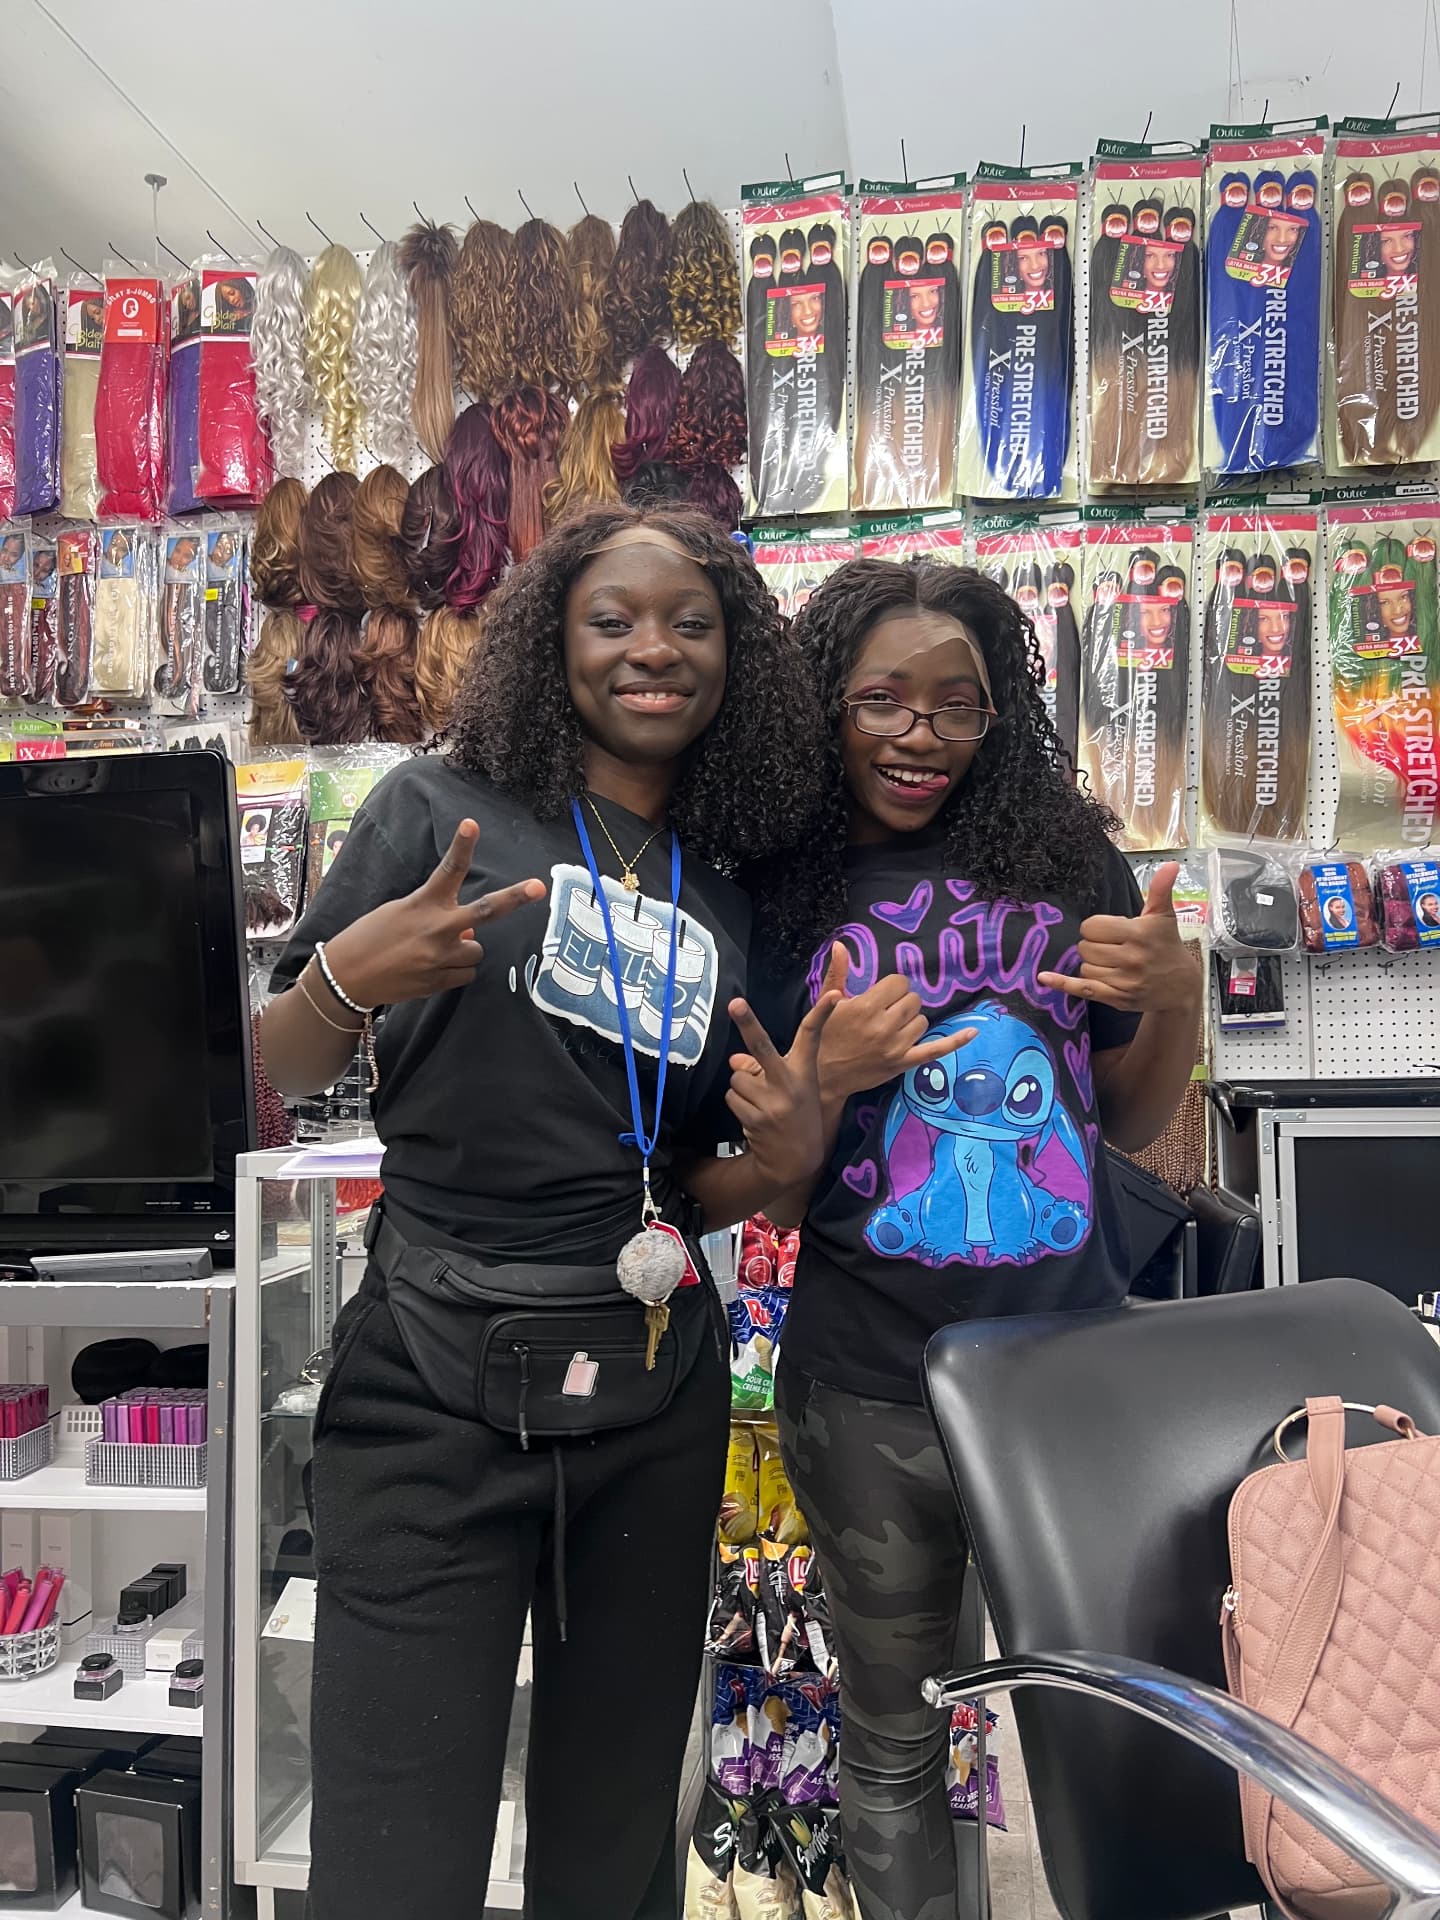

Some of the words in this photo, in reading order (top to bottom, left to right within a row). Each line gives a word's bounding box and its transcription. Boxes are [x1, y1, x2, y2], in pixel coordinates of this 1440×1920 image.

[1216, 127, 1245, 137] Outre
[1346, 120, 1371, 132] Outre
[1101, 143, 1127, 155] Outre
[865, 184, 892, 193] Outre
[979, 165, 1006, 177] Outre
[752, 186, 780, 196] Outre
[1232, 213, 1253, 252] Premium
[992, 252, 1000, 289] Premium
[1114, 244, 1129, 281] Premium
[1351, 234, 1362, 274] Premium
[1252, 263, 1290, 286] 3X
[1380, 274, 1417, 300] 3X
[884, 290, 893, 328] Premium
[1022, 290, 1051, 314] 3X
[1137, 290, 1171, 312] 3X
[793, 335, 821, 358] 3X
[911, 327, 942, 347] 3X
[1367, 310, 1392, 392] X-Pression
[1395, 282, 1419, 420] PRE-STRETCHED
[1122, 331, 1144, 414] X-Pression
[1146, 308, 1169, 440] PRE-STRETCHED
[1238, 316, 1262, 400] X-Pression
[1263, 288, 1286, 426] PRE-STRETCHED
[797, 343, 817, 471] RE-STRETCED
[904, 338, 926, 467] PRE-STRETCHED
[989, 349, 1012, 429] X-Pression
[1010, 324, 1037, 457] PRE-STRETCHED
[1090, 508, 1120, 517] Outre
[1337, 490, 1368, 499] Outre
[758, 531, 787, 541] Outre
[870, 522, 898, 532] Outre
[984, 519, 1013, 529] Outre
[1112, 604, 1123, 643] Premiu
[1228, 609, 1240, 649] Premium
[67, 622, 75, 663] PONY
[1138, 649, 1172, 671] 3X
[1389, 635, 1418, 657] 3X
[1256, 656, 1289, 679] 3X
[1134, 671, 1157, 807] PRE-STRETCHED
[1231, 694, 1256, 778] X-Pression
[1256, 673, 1280, 805] PRE-STRETCHED
[1401, 655, 1439, 843] PRE-STRETCHED
[950, 1794, 966, 1803] ALL
